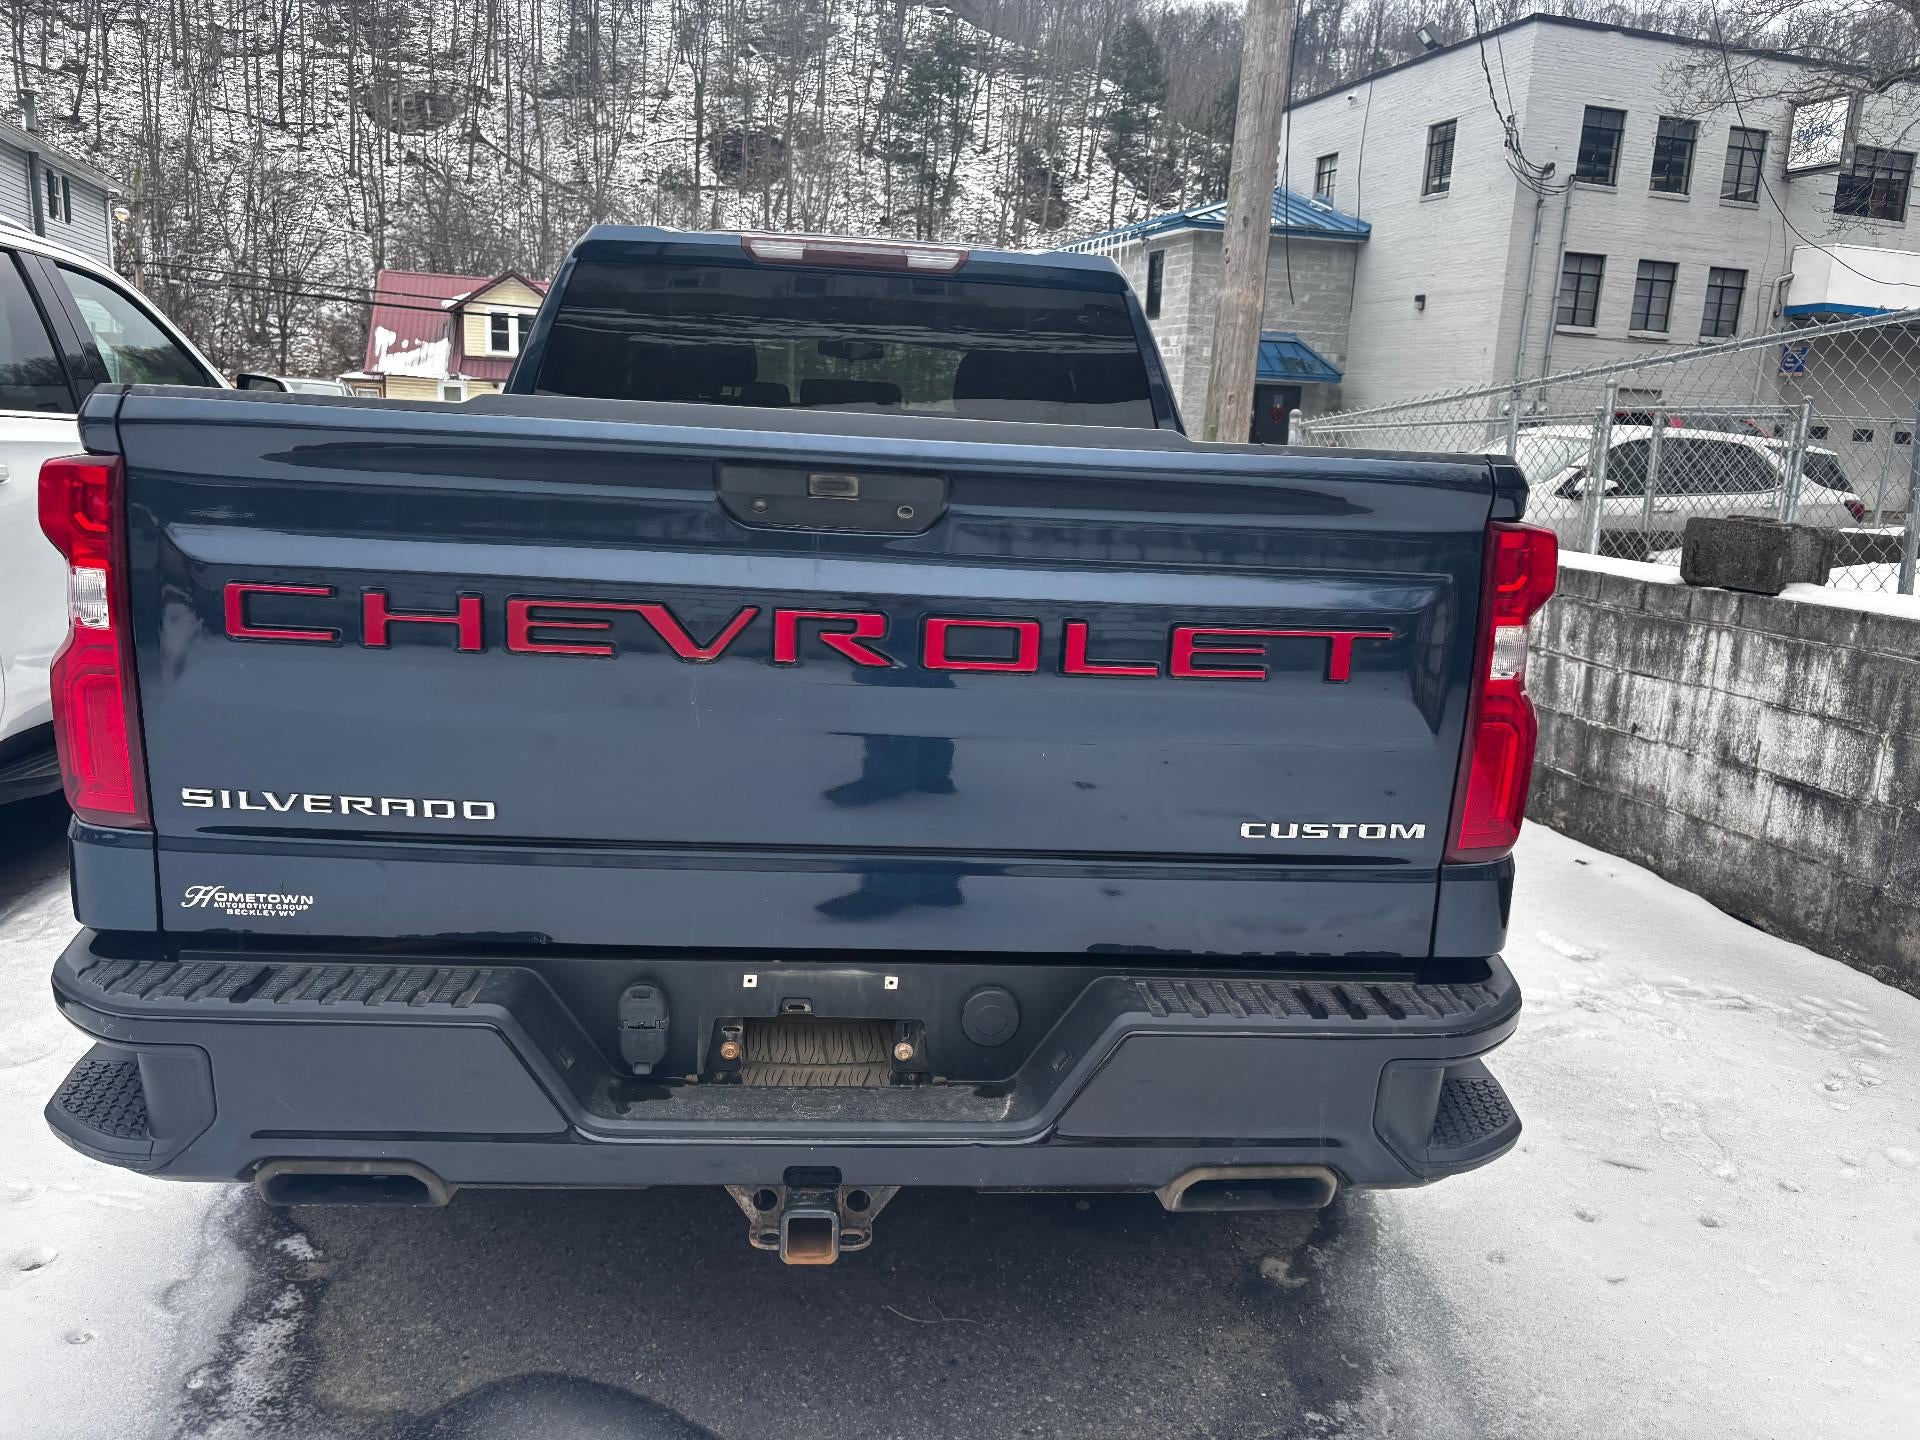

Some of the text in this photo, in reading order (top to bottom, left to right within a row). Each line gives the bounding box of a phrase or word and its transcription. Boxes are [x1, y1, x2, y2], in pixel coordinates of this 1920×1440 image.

[222, 580, 1396, 684] CHEVROLET
[181, 787, 497, 821] SILVERADO
[1240, 822, 1427, 840] CUSTOM
[213, 902, 273, 910] AUTOMOTIVE
[226, 908, 276, 917] BECKLEY
